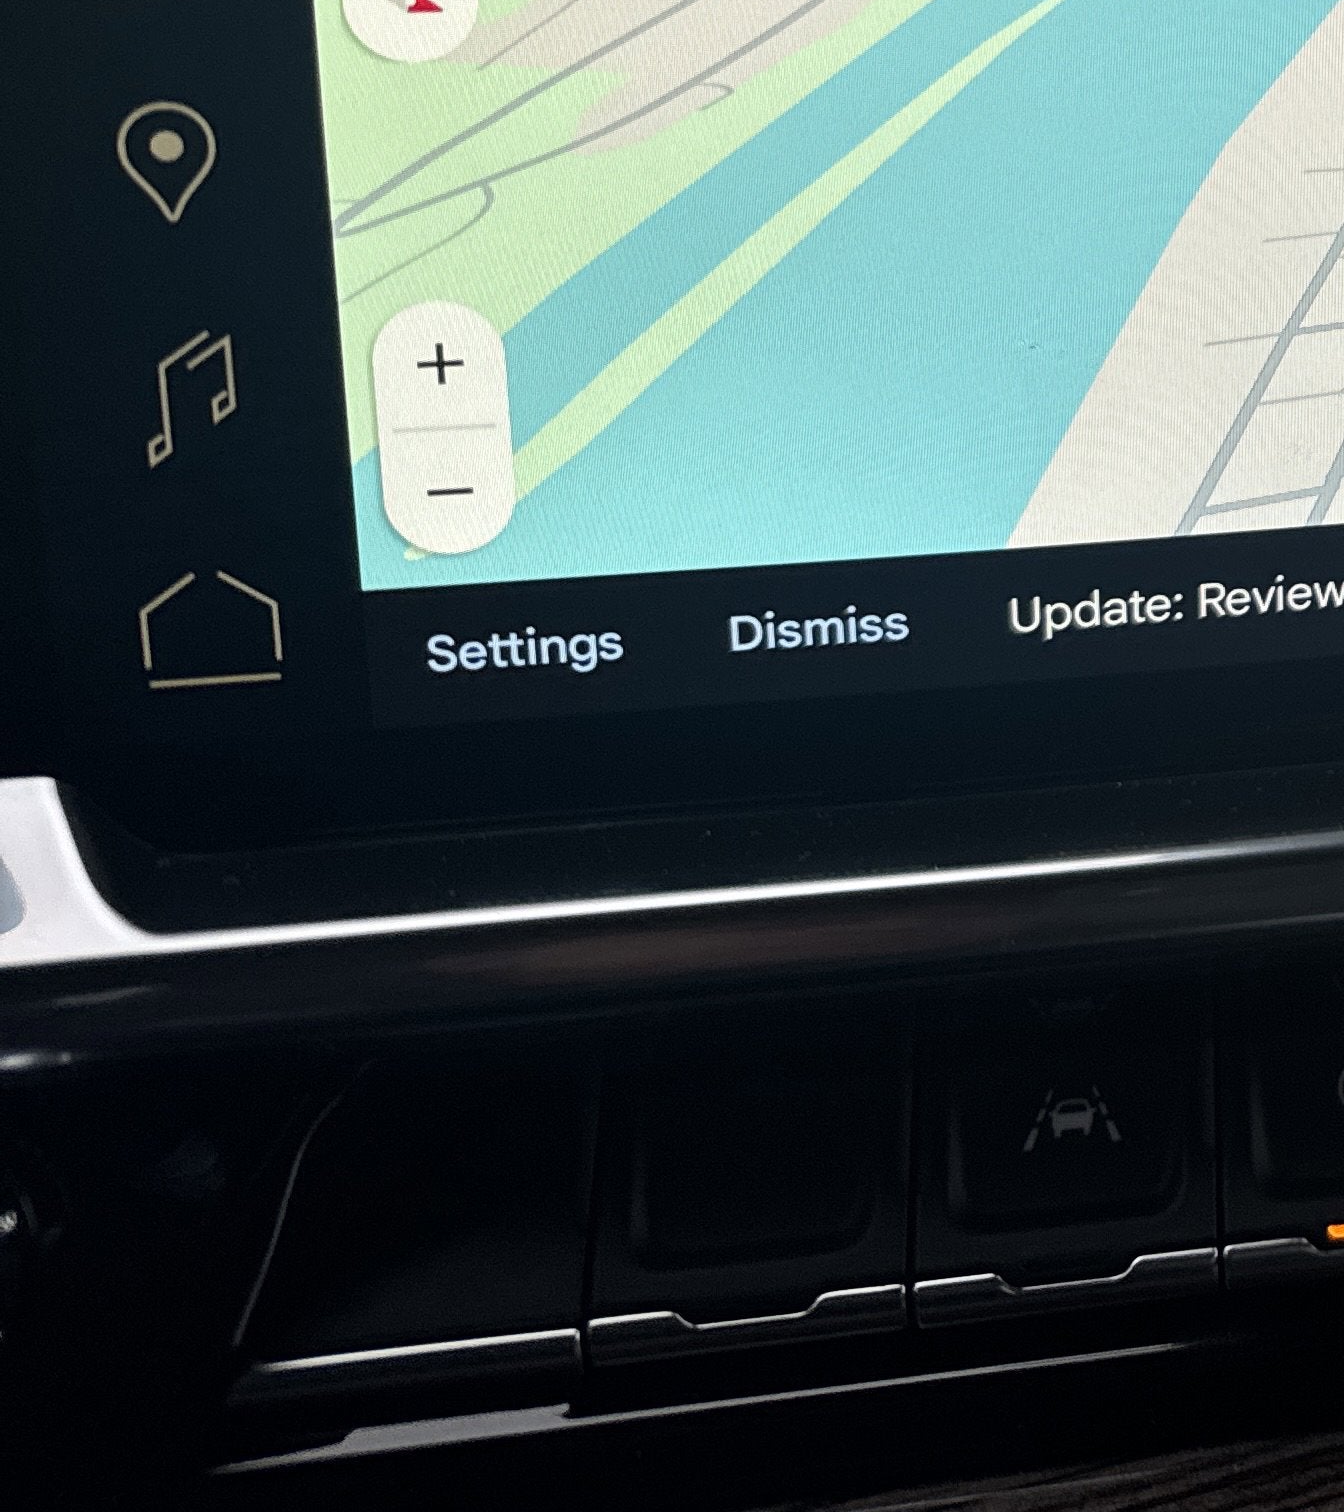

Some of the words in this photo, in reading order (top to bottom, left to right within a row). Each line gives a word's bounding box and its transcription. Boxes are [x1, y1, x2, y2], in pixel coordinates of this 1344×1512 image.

[728, 604, 911, 653] Dismiss
[1008, 587, 1185, 642] Update:
[426, 624, 625, 674] Settings
